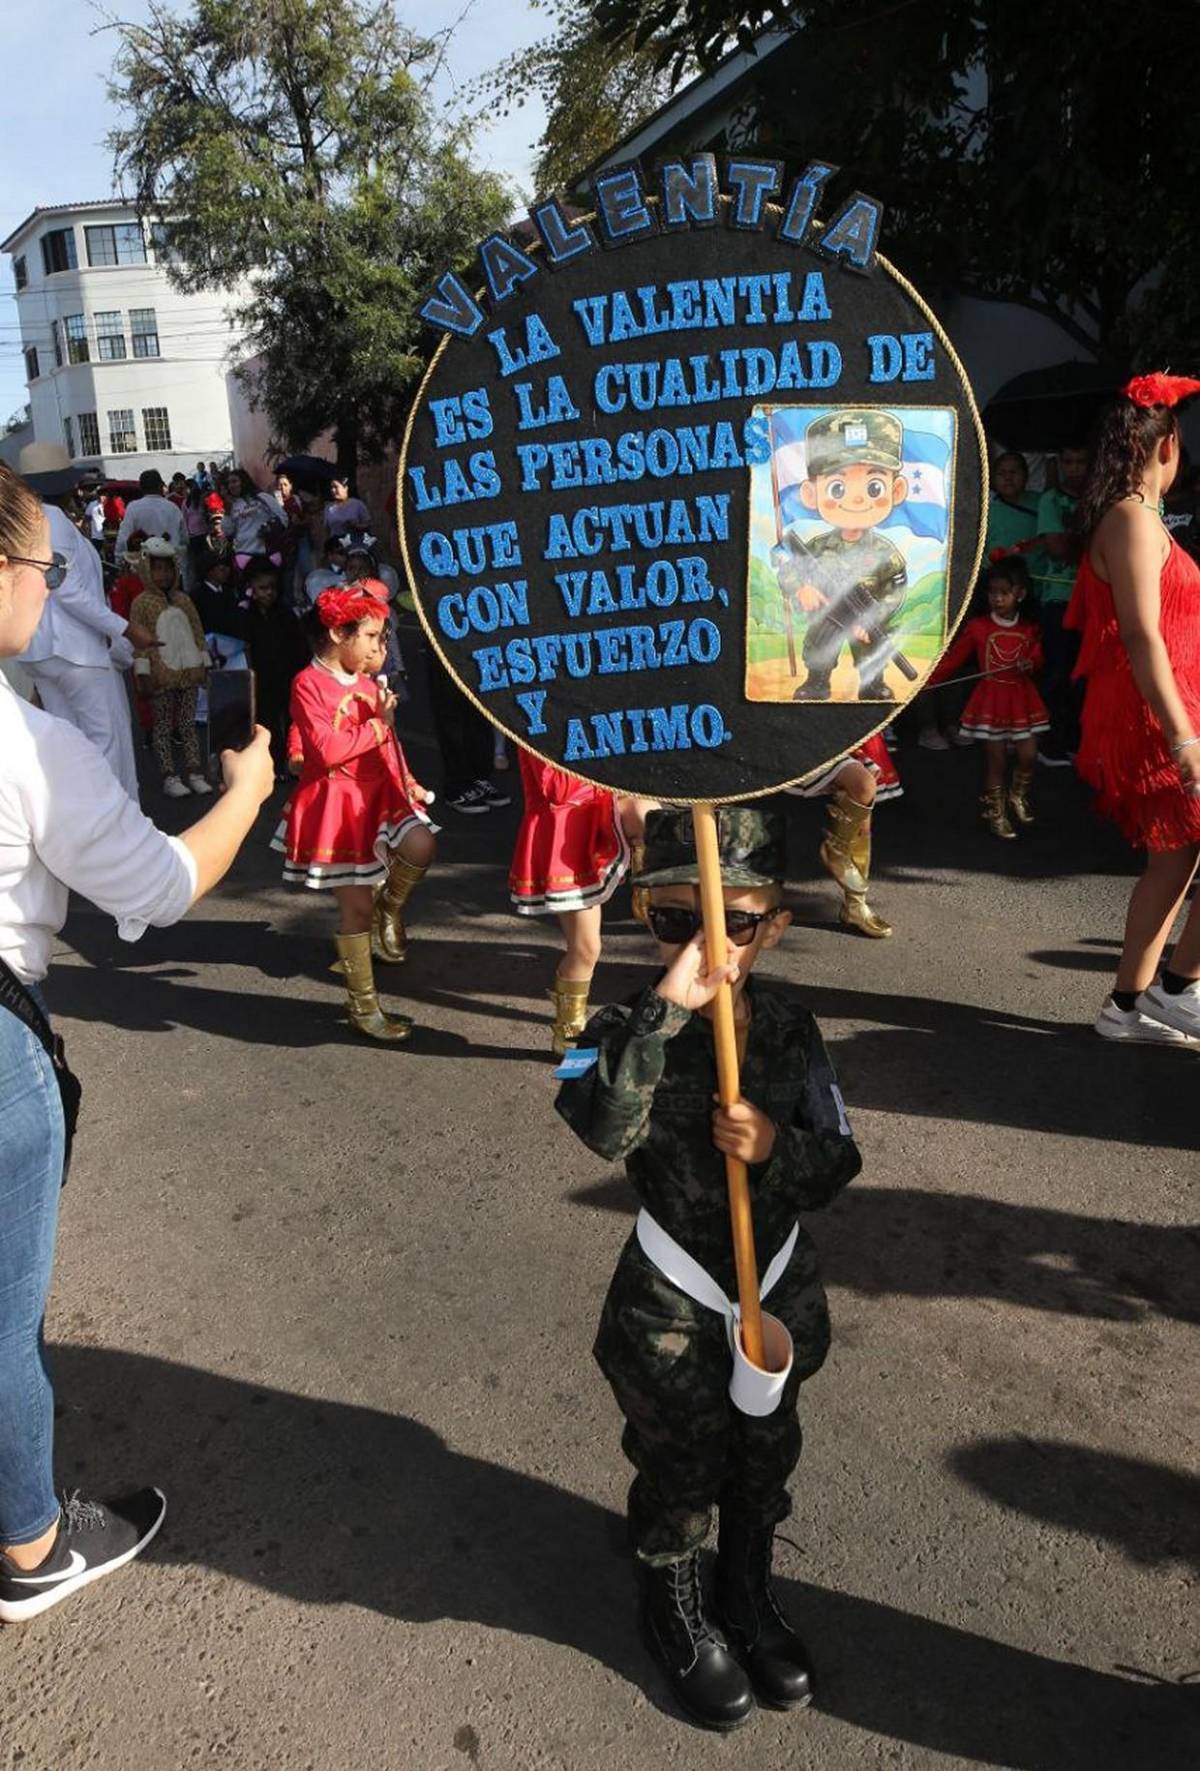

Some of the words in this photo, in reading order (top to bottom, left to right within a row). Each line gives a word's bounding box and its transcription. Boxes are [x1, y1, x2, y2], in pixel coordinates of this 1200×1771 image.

[418, 155, 884, 336] VALENTÍA
[488, 313, 560, 376] LA
[573, 271, 832, 346] VALENTIA
[430, 388, 494, 447] ES
[514, 375, 580, 430] LA
[594, 340, 842, 415] CUALIDAD
[867, 331, 936, 384] DE
[409, 449, 501, 511] LAS
[517, 415, 773, 490] PERSONAS
[419, 521, 522, 577] QUE
[544, 495, 730, 560] ACTUAN
[437, 580, 529, 640] CON
[556, 556, 729, 617] VALOR,
[471, 618, 721, 693] ESFUERZO
[516, 690, 549, 735] Y
[563, 704, 733, 762] ANIMO.
